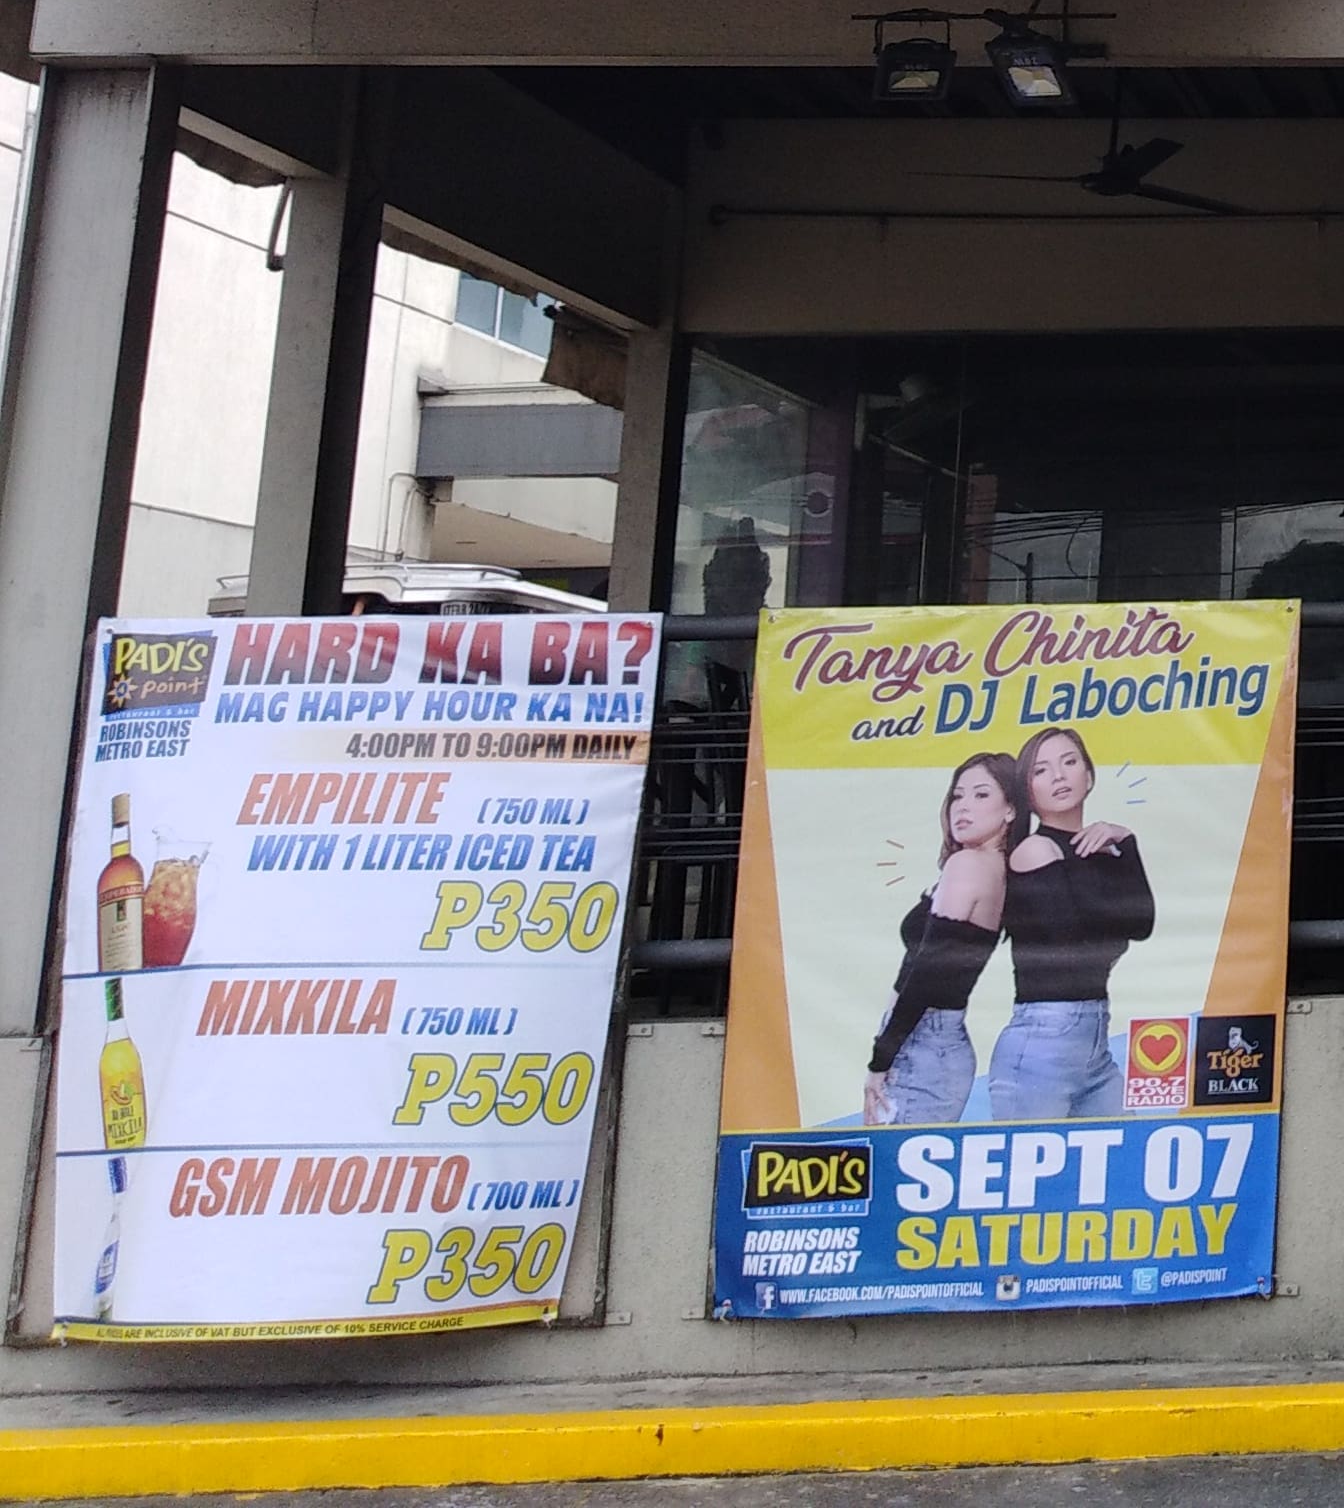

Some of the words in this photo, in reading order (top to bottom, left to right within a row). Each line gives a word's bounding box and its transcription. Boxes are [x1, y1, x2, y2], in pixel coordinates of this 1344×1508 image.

[113, 637, 209, 675] PADI'S
[223, 621, 400, 686] HARD
[418, 621, 503, 685] KA
[528, 621, 655, 686] BA?
[783, 623, 973, 702] Tanya
[984, 607, 1195, 677] Chinita
[140, 673, 205, 699] point
[851, 705, 925, 741] and
[934, 679, 1001, 734] DJ
[1019, 656, 1270, 725] Laboching
[214, 692, 290, 723] MAG
[297, 691, 413, 723] HAPPY
[423, 691, 517, 722] HOUR
[526, 692, 571, 722] KA
[583, 692, 645, 723] NA!
[100, 719, 192, 742] ROBINSONS
[346, 732, 436, 759] 4:00PM
[443, 733, 470, 758] TO
[476, 733, 568, 759] 9:00PM
[571, 735, 637, 760] DAILY
[95, 739, 142, 762] METRO
[145, 738, 191, 759] EAST
[236, 772, 452, 825] EMPILITE
[247, 834, 339, 871] WITH
[342, 834, 362, 870] 1
[361, 834, 452, 871] LITER
[454, 834, 533, 871] ICED
[539, 835, 597, 872] TEA
[419, 879, 619, 952] P350
[196, 978, 397, 1036] MIXKILA
[1207, 1048, 1264, 1078] Tiger
[393, 1051, 595, 1126] P550
[1127, 1095, 1184, 1106] RADIO
[1128, 1086, 1184, 1097] LOVE
[1208, 1078, 1259, 1093] BLACK
[757, 1150, 865, 1198] PADI'S
[896, 1129, 1124, 1213] SEPT
[1144, 1123, 1254, 1203] 07
[169, 1155, 281, 1218] GSM
[279, 1154, 471, 1215] MOJITO
[743, 1227, 860, 1253] ROBINSONS
[896, 1203, 1237, 1270] SATURDAY
[366, 1222, 567, 1305] P350
[742, 1252, 808, 1276] METRO
[808, 1250, 862, 1274] EAST
[1160, 1267, 1228, 1287] @PADISPOINT
[780, 1282, 984, 1304] WWW.FACEBOOK.COM/PADISPOINTOFFICIAL
[1026, 1274, 1123, 1293] PADISPOINTOFFICIAL
[144, 1327, 194, 1339] INCLUSIVE
[195, 1327, 209, 1337] OF
[211, 1327, 231, 1337] VAT
[232, 1325, 256, 1337] BUT
[258, 1323, 322, 1336] EXCLUSIVE
[325, 1324, 342, 1334] OF
[344, 1323, 366, 1335] 10%
[368, 1320, 417, 1333] SERVICE
[419, 1316, 465, 1331] CHARGE
